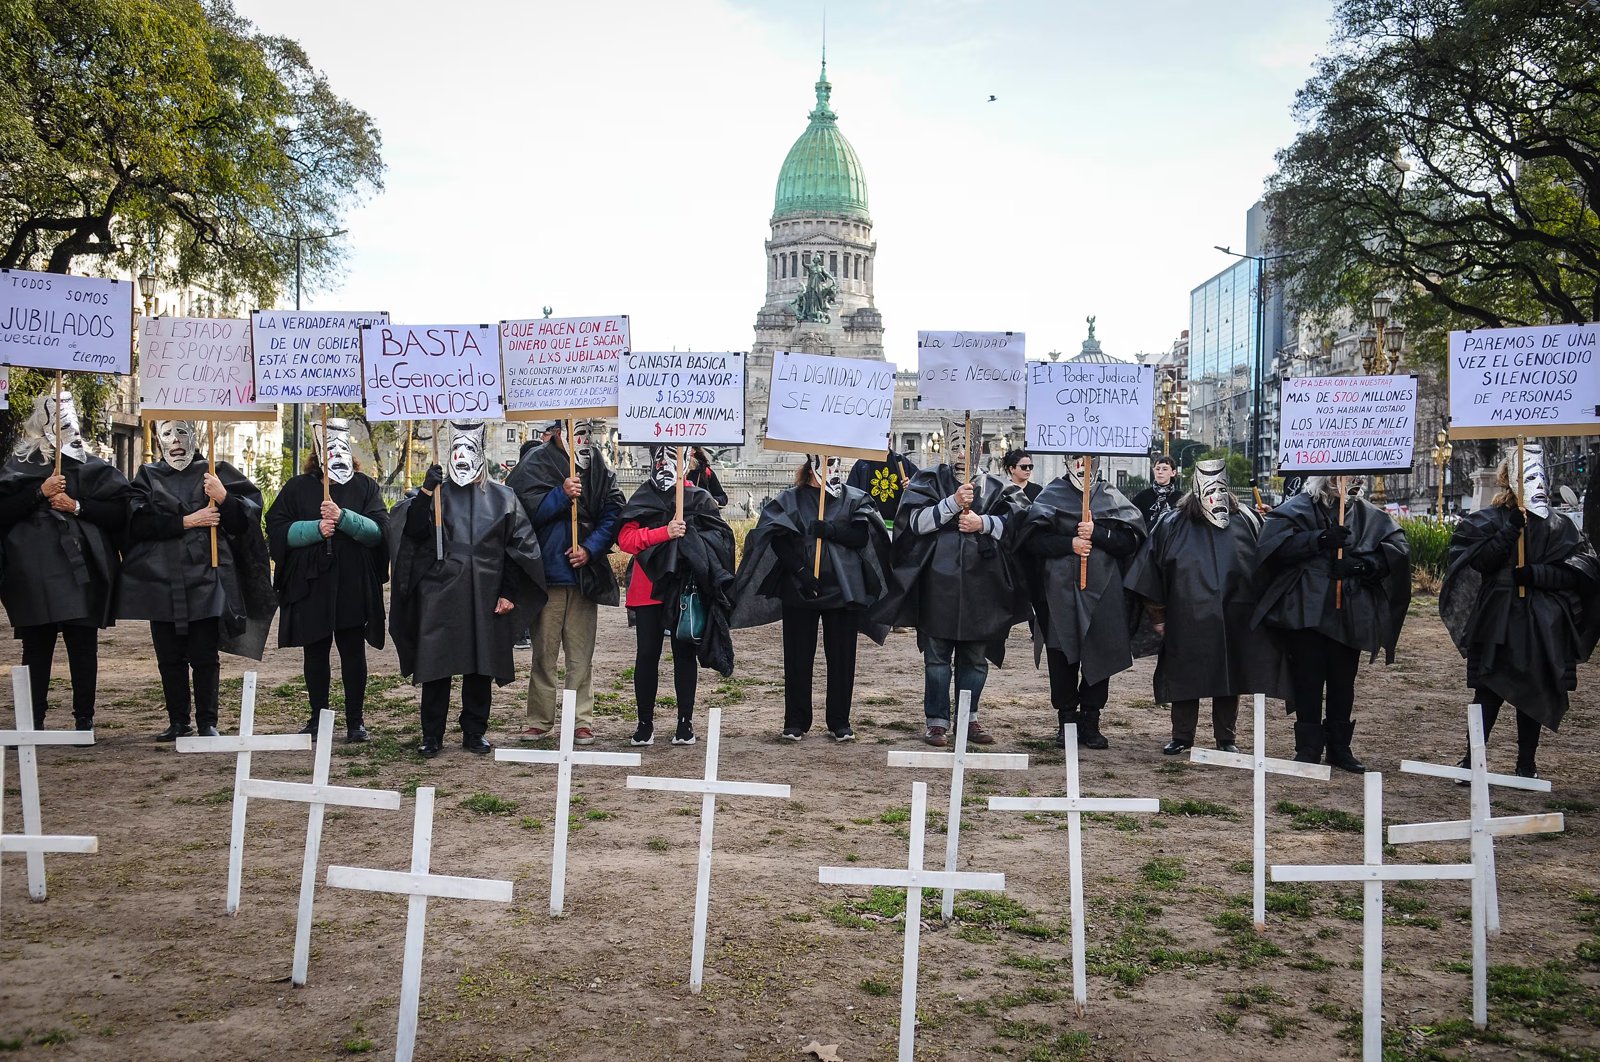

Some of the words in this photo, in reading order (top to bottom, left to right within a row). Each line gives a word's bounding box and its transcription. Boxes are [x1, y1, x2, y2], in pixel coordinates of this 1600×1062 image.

[12, 277, 52, 290] TODOS
[66, 290, 108, 305] SOMOS
[1, 307, 114, 338] JUBILADOS
[259, 317, 276, 329] LA
[282, 317, 345, 329] VERDADERA
[503, 323, 534, 338] ¿QUE
[538, 322, 575, 335] HACEN
[580, 321, 601, 334] CON
[605, 320, 618, 332] EL
[145, 321, 162, 336] EL
[172, 322, 232, 339] ESTADO
[68, 341, 77, 349] de
[270, 338, 286, 349] DE
[293, 338, 310, 349] UN
[318, 337, 360, 349] GOBIER
[381, 328, 482, 356] BASTA
[509, 339, 547, 351] DINERO
[551, 337, 571, 349] QUE
[575, 336, 589, 348] LE
[593, 334, 625, 346] SACAN
[1464, 335, 1535, 352] PAREMOS
[1542, 334, 1561, 349] DE
[1568, 333, 1596, 347] UNA
[73, 351, 115, 367] tiempo
[259, 353, 288, 365] ESTÁ
[293, 354, 308, 364] EN
[312, 354, 340, 364] COMO
[528, 353, 535, 364] A
[539, 352, 561, 363] LXS
[629, 355, 682, 370] CANASTA
[686, 355, 726, 370] BASICA
[1458, 356, 1486, 369] VEZ
[1493, 355, 1509, 367] EL
[1514, 350, 1592, 366] GENOCIDIO
[147, 364, 170, 378] DE
[262, 370, 271, 379] A
[275, 369, 296, 378] LXS
[301, 368, 356, 378] ANCIANXS
[509, 368, 516, 376] SI
[519, 367, 528, 375] NO
[529, 366, 577, 375] CONSTRUYEN
[580, 365, 605, 373] RUTAS
[608, 364, 617, 372] NI
[778, 364, 797, 381] LA
[867, 372, 891, 390] NO
[940, 369, 958, 381] SE
[1033, 366, 1053, 384] El
[1062, 365, 1094, 382] Poder
[1098, 366, 1141, 383] Judicial
[558, 377, 567, 385] NI
[570, 375, 619, 384] HOSPITALES
[626, 373, 680, 387] ADULTO
[1334, 379, 1347, 387] CON
[1349, 379, 1357, 387] LA
[1482, 370, 1577, 386] SILENCIOSO
[155, 387, 231, 406] NUESTRA
[259, 385, 278, 396] LOS
[281, 385, 302, 396] MAS
[537, 388, 562, 397] CIERTO
[563, 388, 577, 396] QUE
[580, 388, 589, 396] LA
[1286, 393, 1310, 403] MAS
[1316, 392, 1330, 403] DE
[1333, 391, 1359, 403] 5700
[1361, 390, 1413, 402] MILLONES
[1474, 393, 1492, 404] DE
[1501, 389, 1572, 403] PERSONAS
[782, 392, 811, 410] SE
[1067, 413, 1074, 422] a
[1084, 407, 1099, 423] los
[1337, 406, 1372, 414] HABRIAN
[1375, 405, 1405, 413] COSTADO
[1491, 406, 1559, 420] MAYORES
[1291, 418, 1312, 430] LOS
[1320, 416, 1357, 430] VIAJES
[1362, 418, 1375, 429] DE
[1377, 417, 1408, 429] MILEI
[1037, 424, 1149, 447] RESPONSABLES
[1284, 439, 1303, 449] UNA
[1307, 438, 1350, 448] FORTUNA
[1352, 437, 1412, 447] EQUIVALENTE
[1281, 453, 1290, 464] A
[1331, 449, 1404, 462] JUBILACIONES
